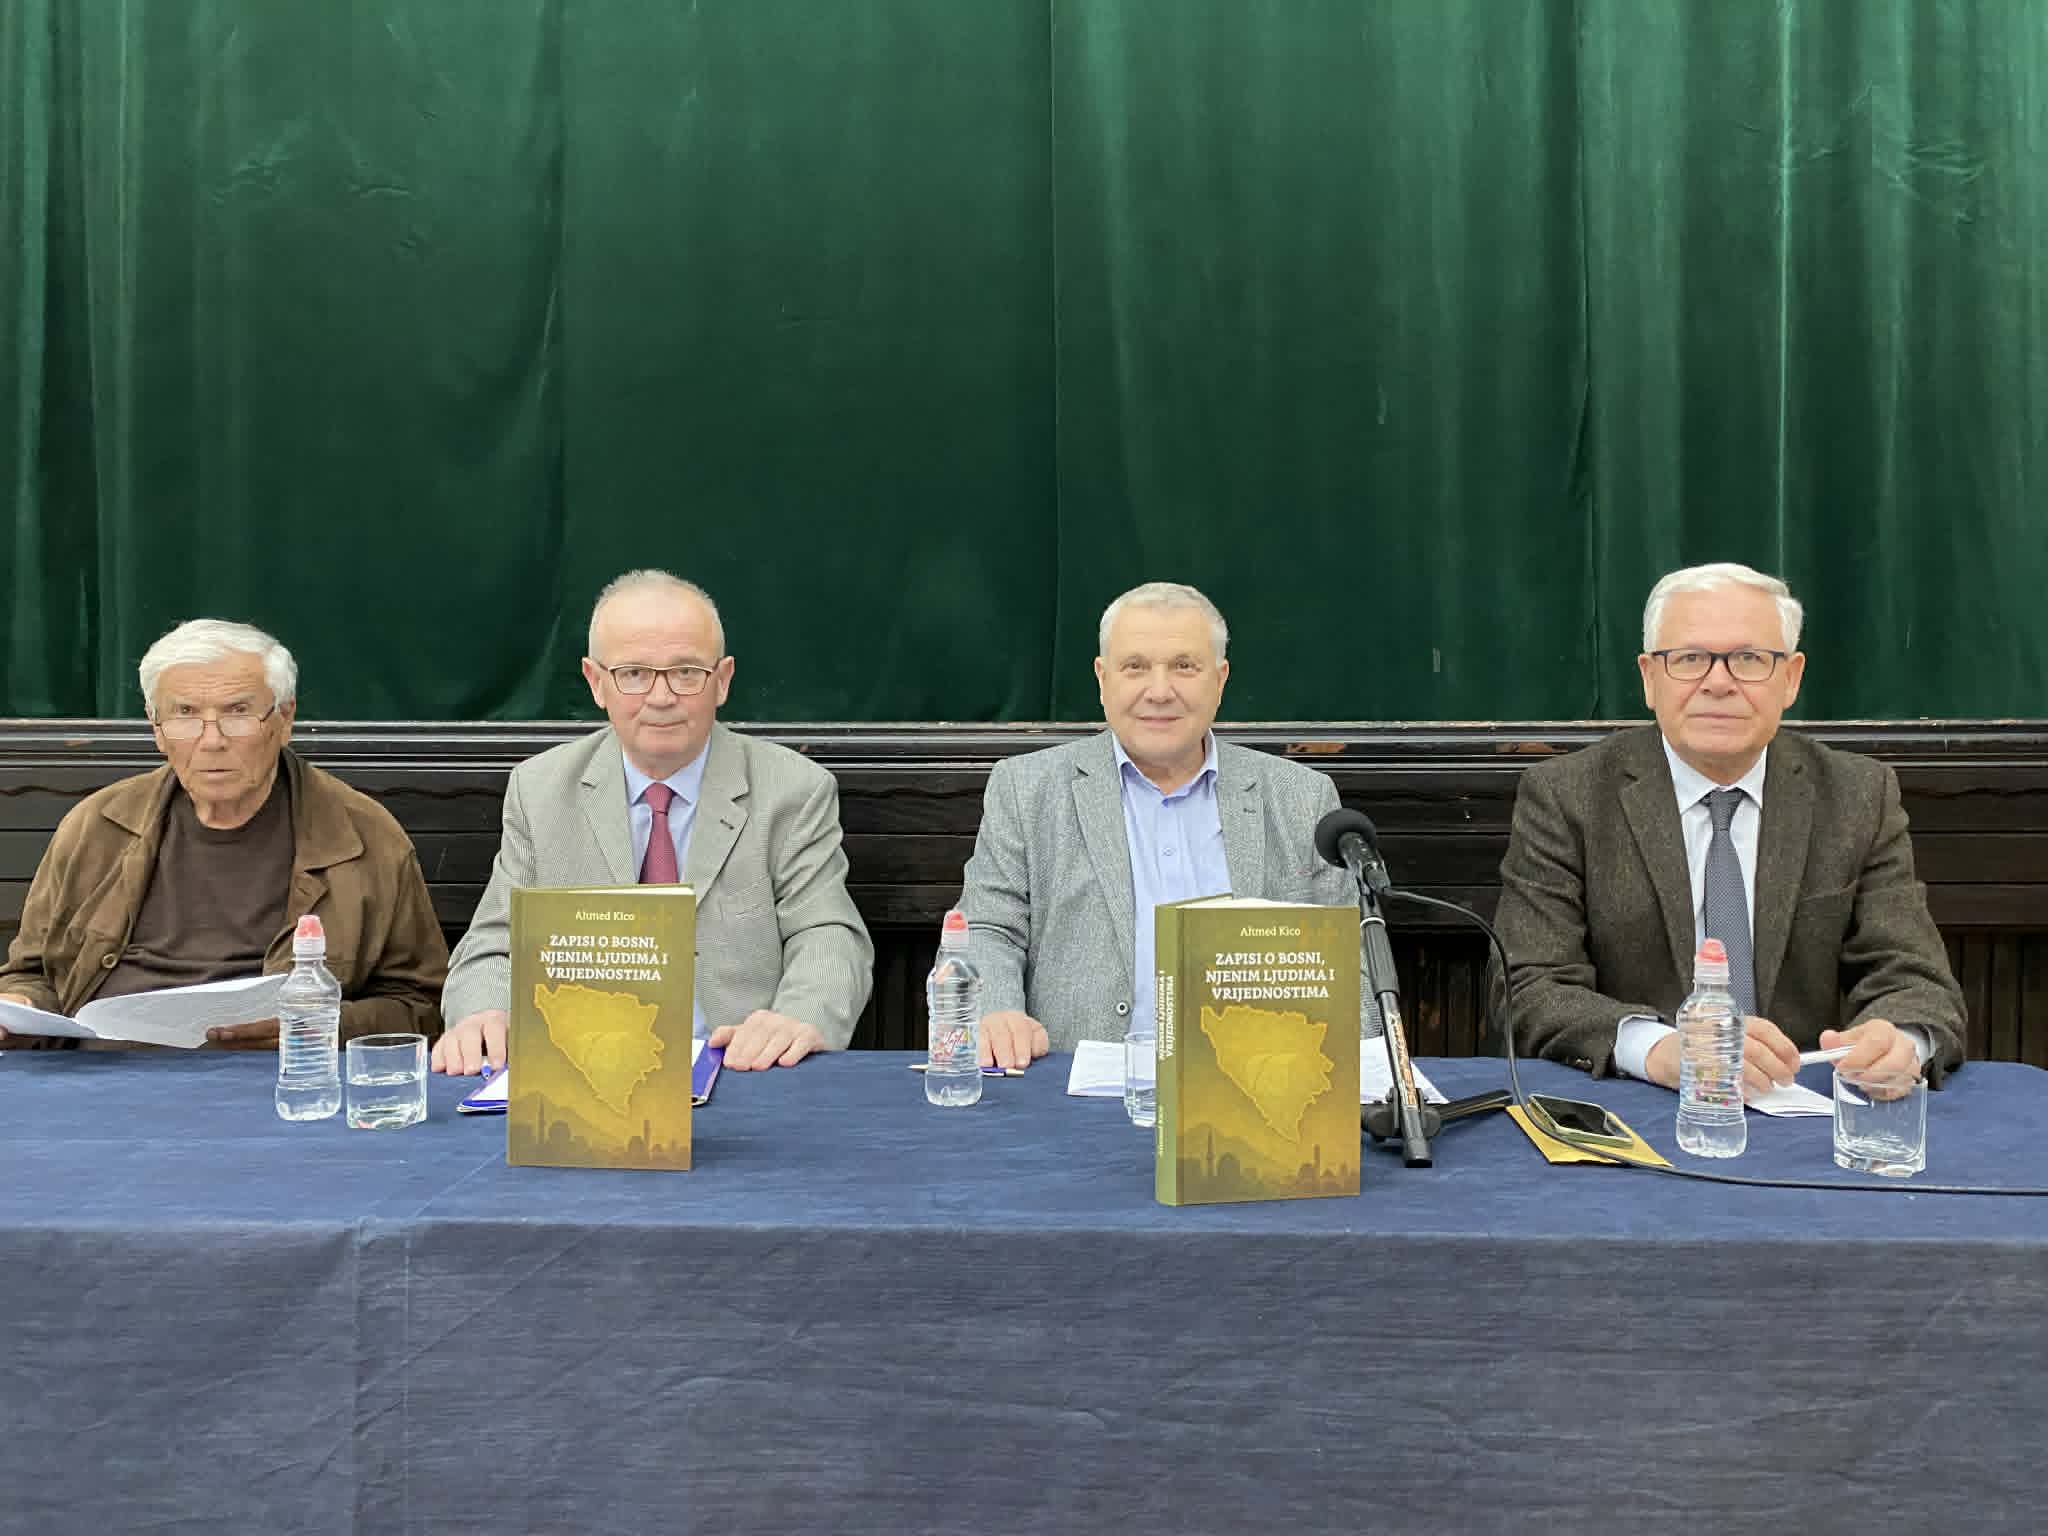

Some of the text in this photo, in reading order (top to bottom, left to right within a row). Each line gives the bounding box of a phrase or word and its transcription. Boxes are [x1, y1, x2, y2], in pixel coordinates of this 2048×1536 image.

[575, 911, 636, 921] Ahmed Kico
[1240, 925, 1301, 937] Ahmed Kico
[550, 935, 659, 950] ZAPISI O BOSNI,
[540, 951, 669, 967] NJENIM LJUDIMA I
[1215, 952, 1325, 966] ZAPISI O BOSNI,
[546, 966, 662, 982] VRIJEDNOSTIMA
[1206, 968, 1336, 985] NJENIM LJUDIMA I
[1212, 986, 1329, 1002] VRIJEDNOSTIMA
